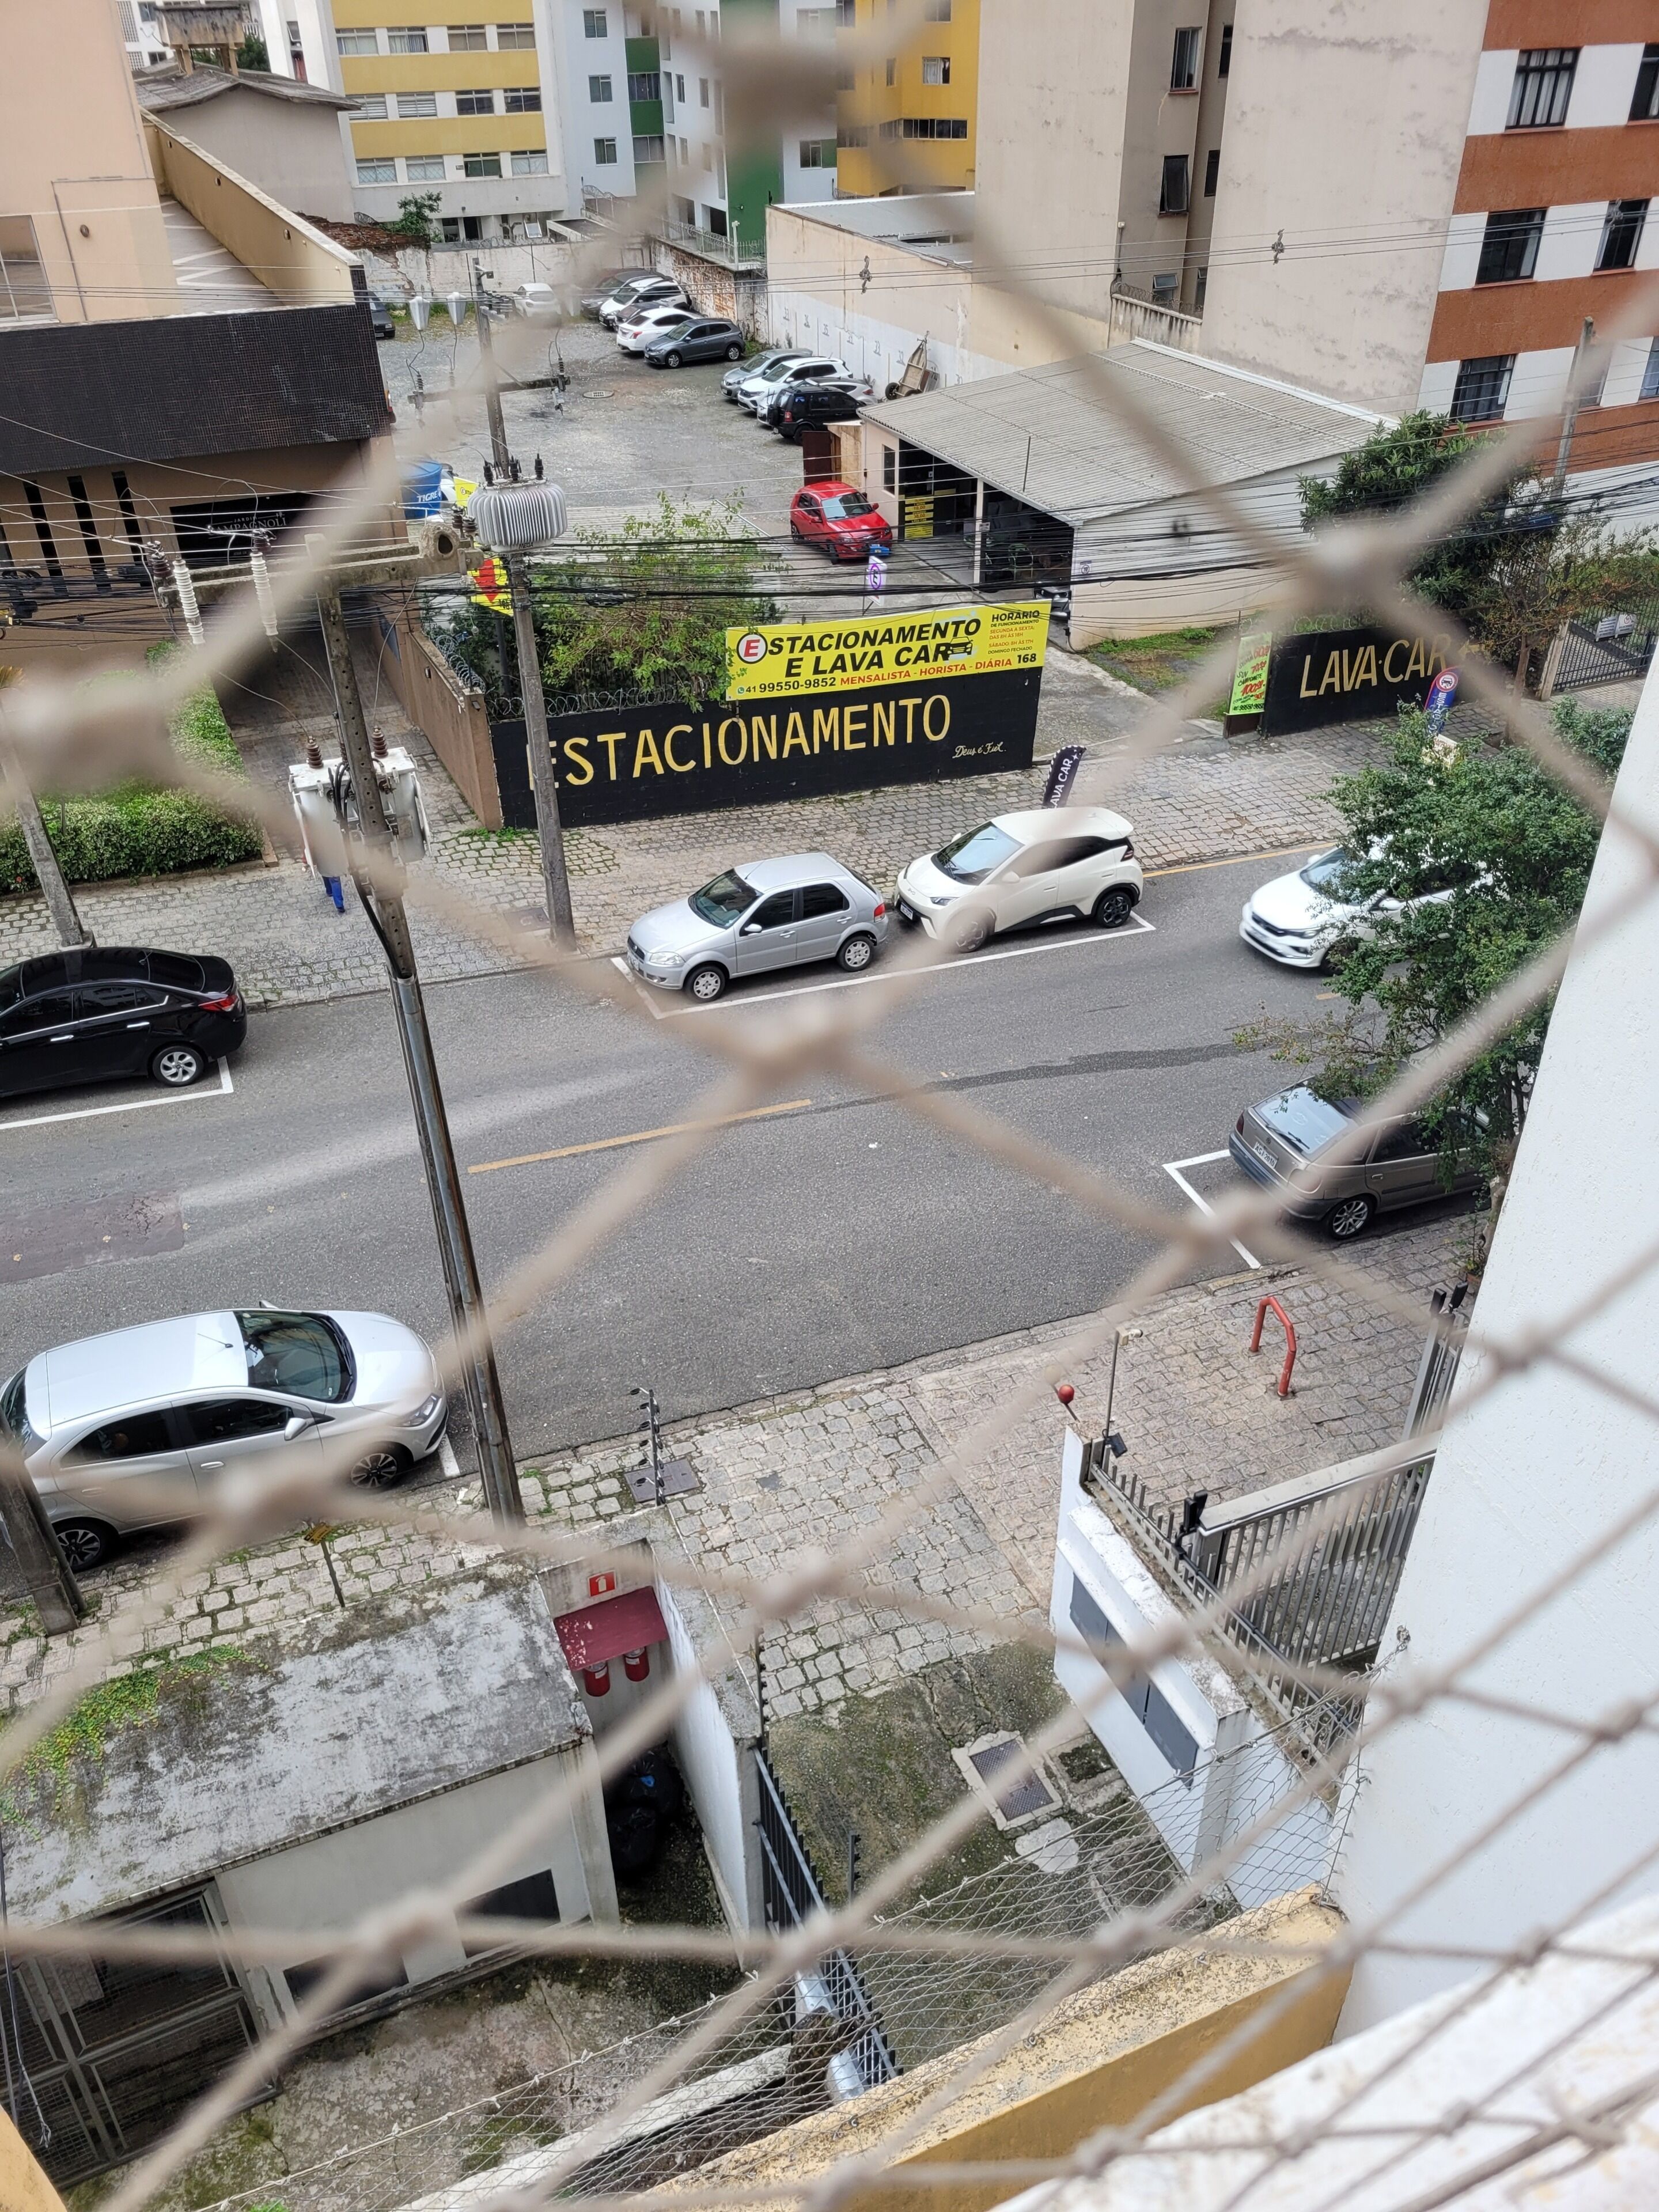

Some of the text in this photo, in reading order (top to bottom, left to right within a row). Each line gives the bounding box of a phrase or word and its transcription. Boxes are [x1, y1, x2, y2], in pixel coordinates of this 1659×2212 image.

[416, 490, 438, 502] TIGRE
[759, 677, 836, 693] 99550-9852
[840, 670, 911, 685] MENSALISTA
[919, 664, 967, 676] HORISTA
[975, 658, 1012, 670] DIÁRIA
[1017, 653, 1037, 664] 168
[785, 642, 950, 678] E LAVA CAR
[1058, 758, 1073, 782] CAR
